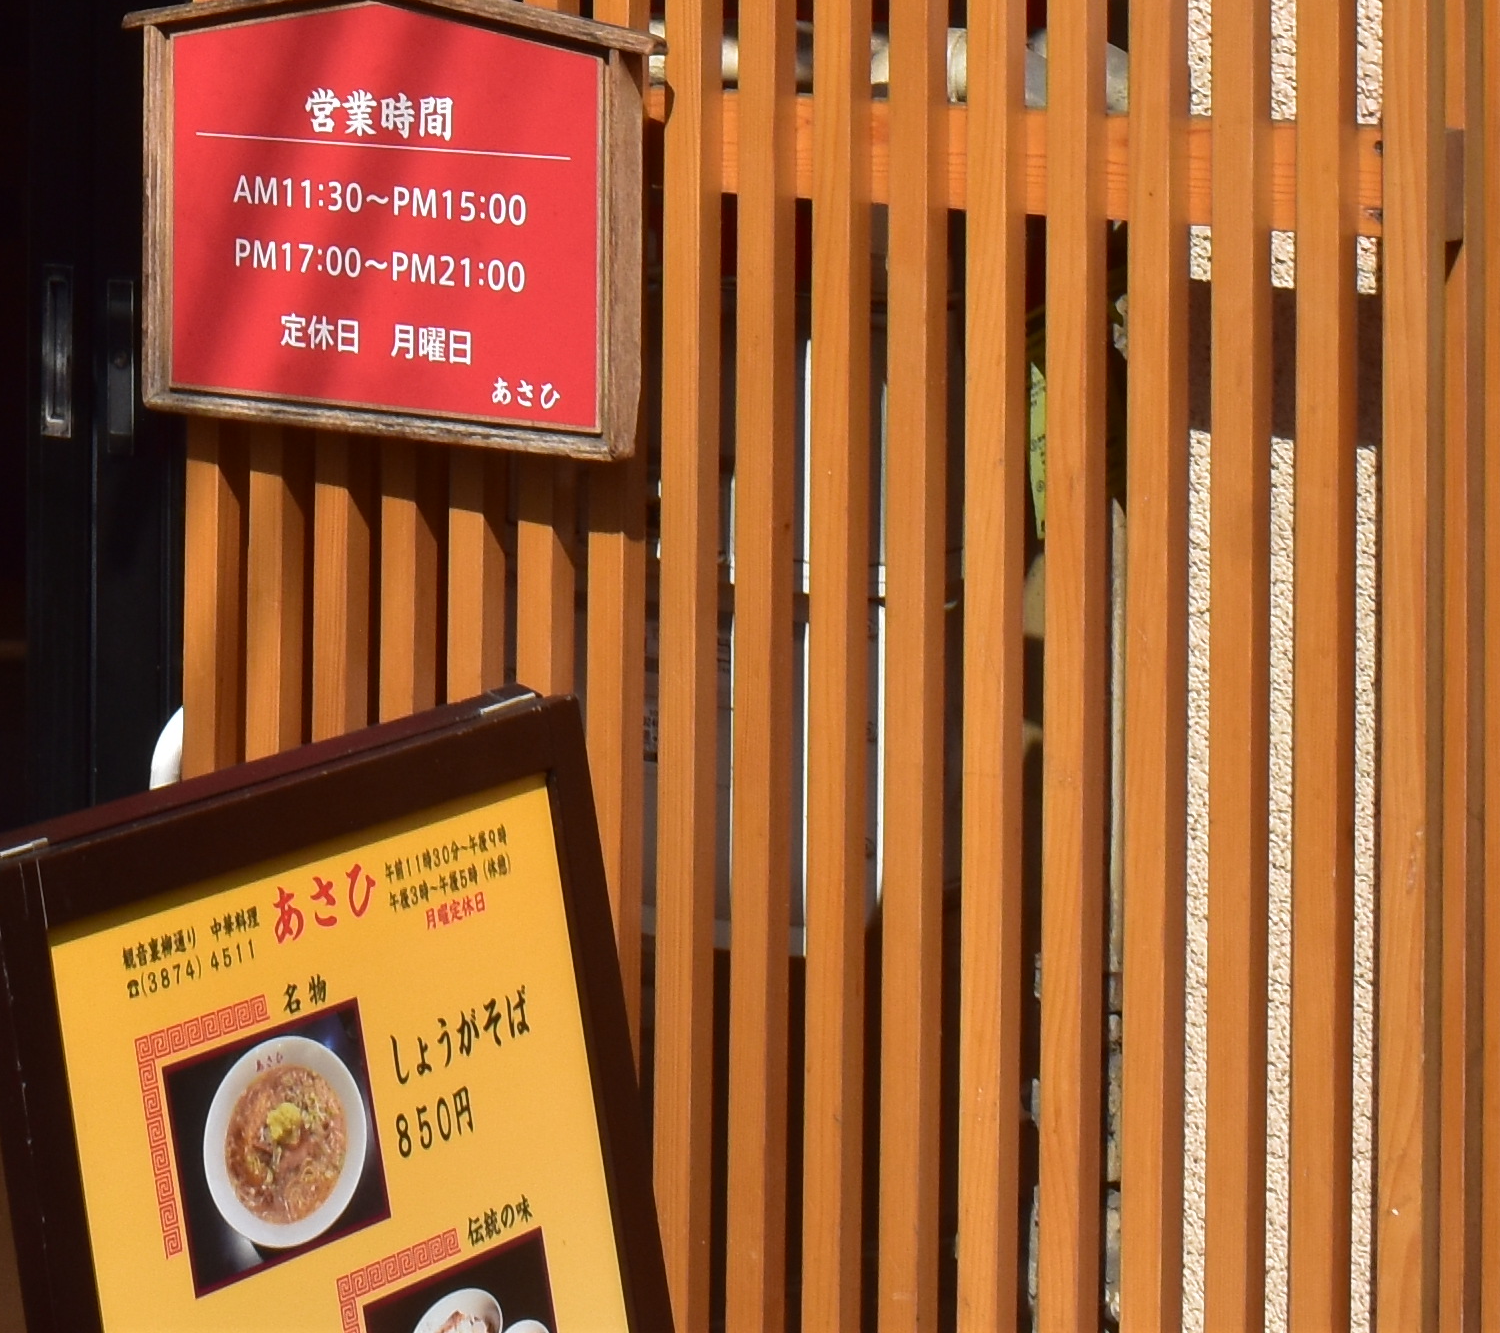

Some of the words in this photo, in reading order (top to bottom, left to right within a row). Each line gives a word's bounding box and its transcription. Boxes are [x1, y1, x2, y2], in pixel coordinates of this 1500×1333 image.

[304, 87, 453, 141] 営業時間
[280, 312, 359, 354] 定休日
[391, 323, 472, 366] 月曜日
[491, 376, 561, 410] あさひ
[272, 862, 377, 945] あさひ
[424, 891, 487, 931] 月曜定休日
[121, 925, 197, 971] 観音裏柳通り
[209, 905, 260, 943] 中華料理
[210, 938, 257, 973] 4511
[283, 974, 327, 1015] 名物
[389, 984, 531, 1085] しょうがそば
[395, 1085, 475, 1158] 850円
[467, 1194, 533, 1247] 伝統の味
